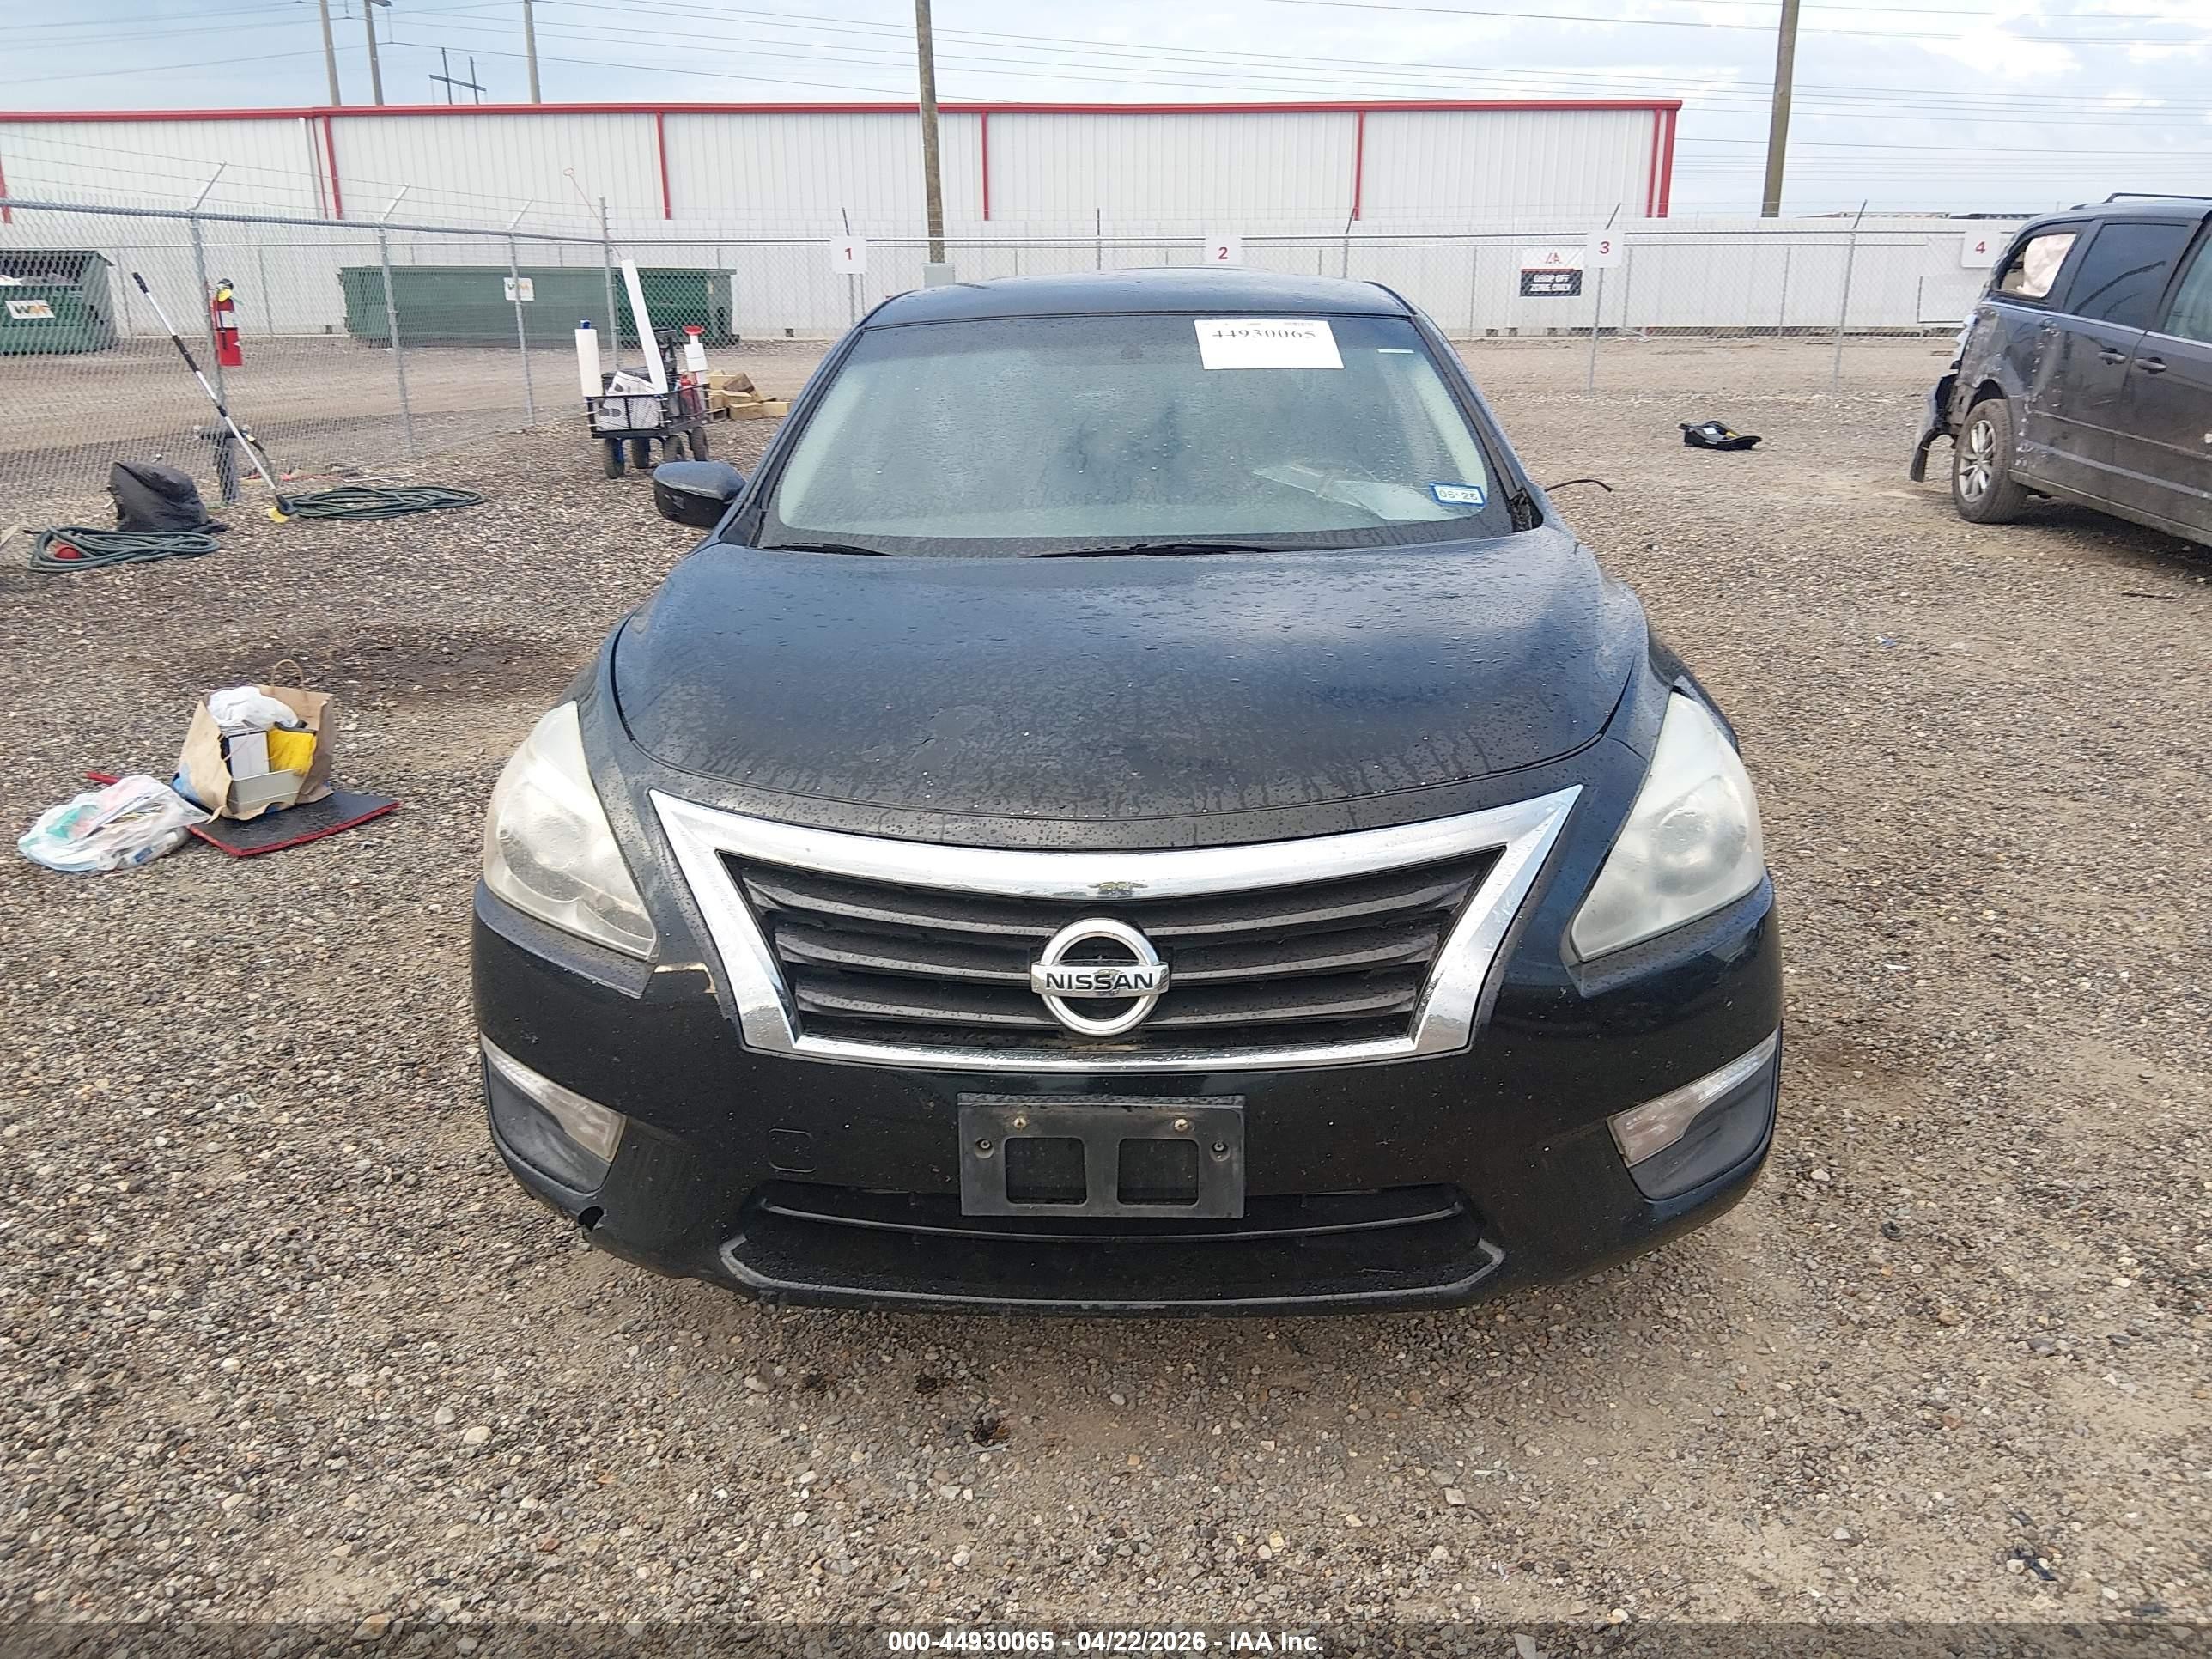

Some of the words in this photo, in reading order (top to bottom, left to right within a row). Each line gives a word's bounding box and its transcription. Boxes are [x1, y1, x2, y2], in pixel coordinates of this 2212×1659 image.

[844, 247, 853, 260] 1
[1218, 246, 1229, 259] 2
[1599, 240, 1611, 254] 3
[1974, 240, 1986, 254] 4
[1212, 328, 1316, 340] 44930065
[1045, 972, 1153, 990] NISSAN
